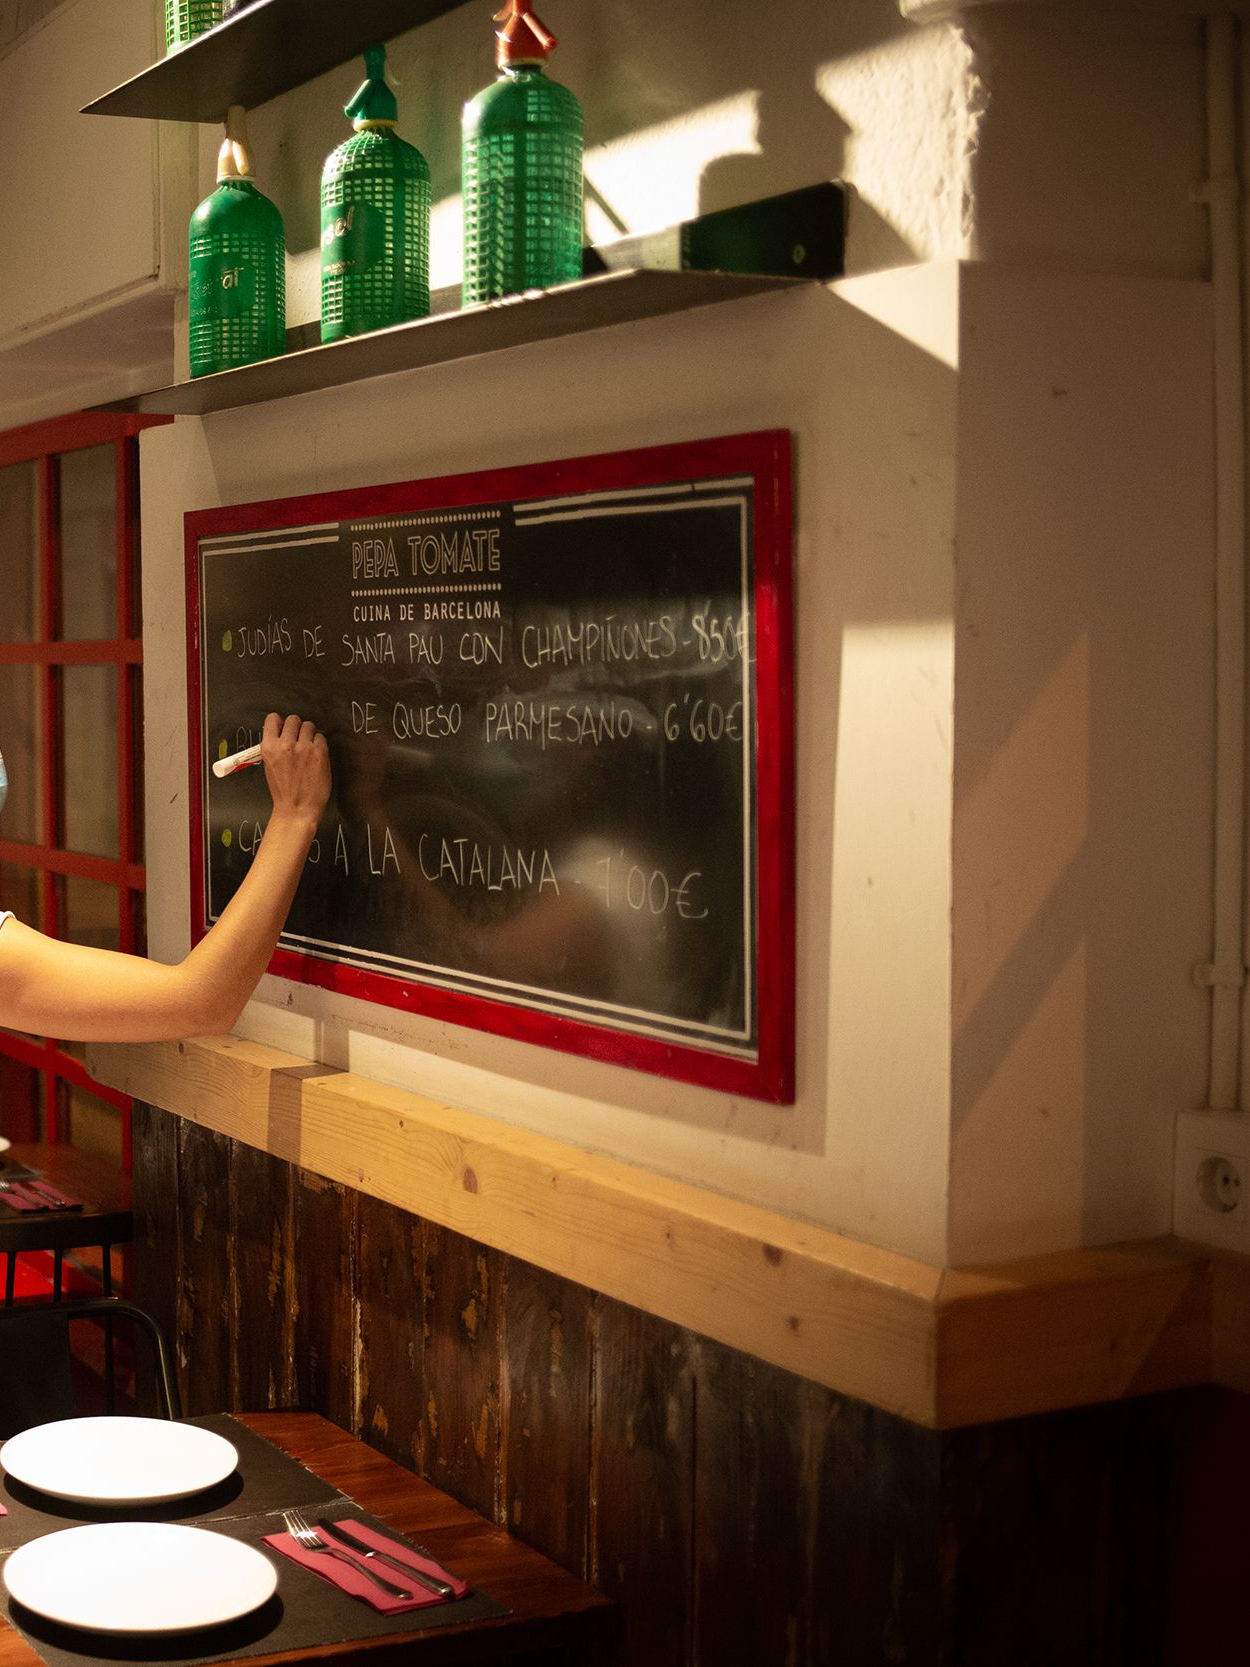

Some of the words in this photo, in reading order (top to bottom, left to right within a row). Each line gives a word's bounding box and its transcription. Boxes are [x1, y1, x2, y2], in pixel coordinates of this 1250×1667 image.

[351, 537, 400, 580] PEPA
[407, 528, 501, 576] TOMATE
[353, 604, 391, 622] CUINA
[399, 604, 415, 621] DE
[423, 601, 501, 621] BARCELONA
[237, 614, 292, 658] JUDÍAS
[302, 625, 326, 658] DE
[341, 632, 396, 667] SANTA
[408, 632, 444, 665] PAU
[458, 625, 504, 666] CON
[351, 700, 379, 734] DE
[392, 701, 462, 740] QUESO
[485, 700, 633, 750] PARMESANO
[334, 823, 349, 878] A
[366, 823, 401, 876] LA
[418, 833, 560, 896] CATALANA
